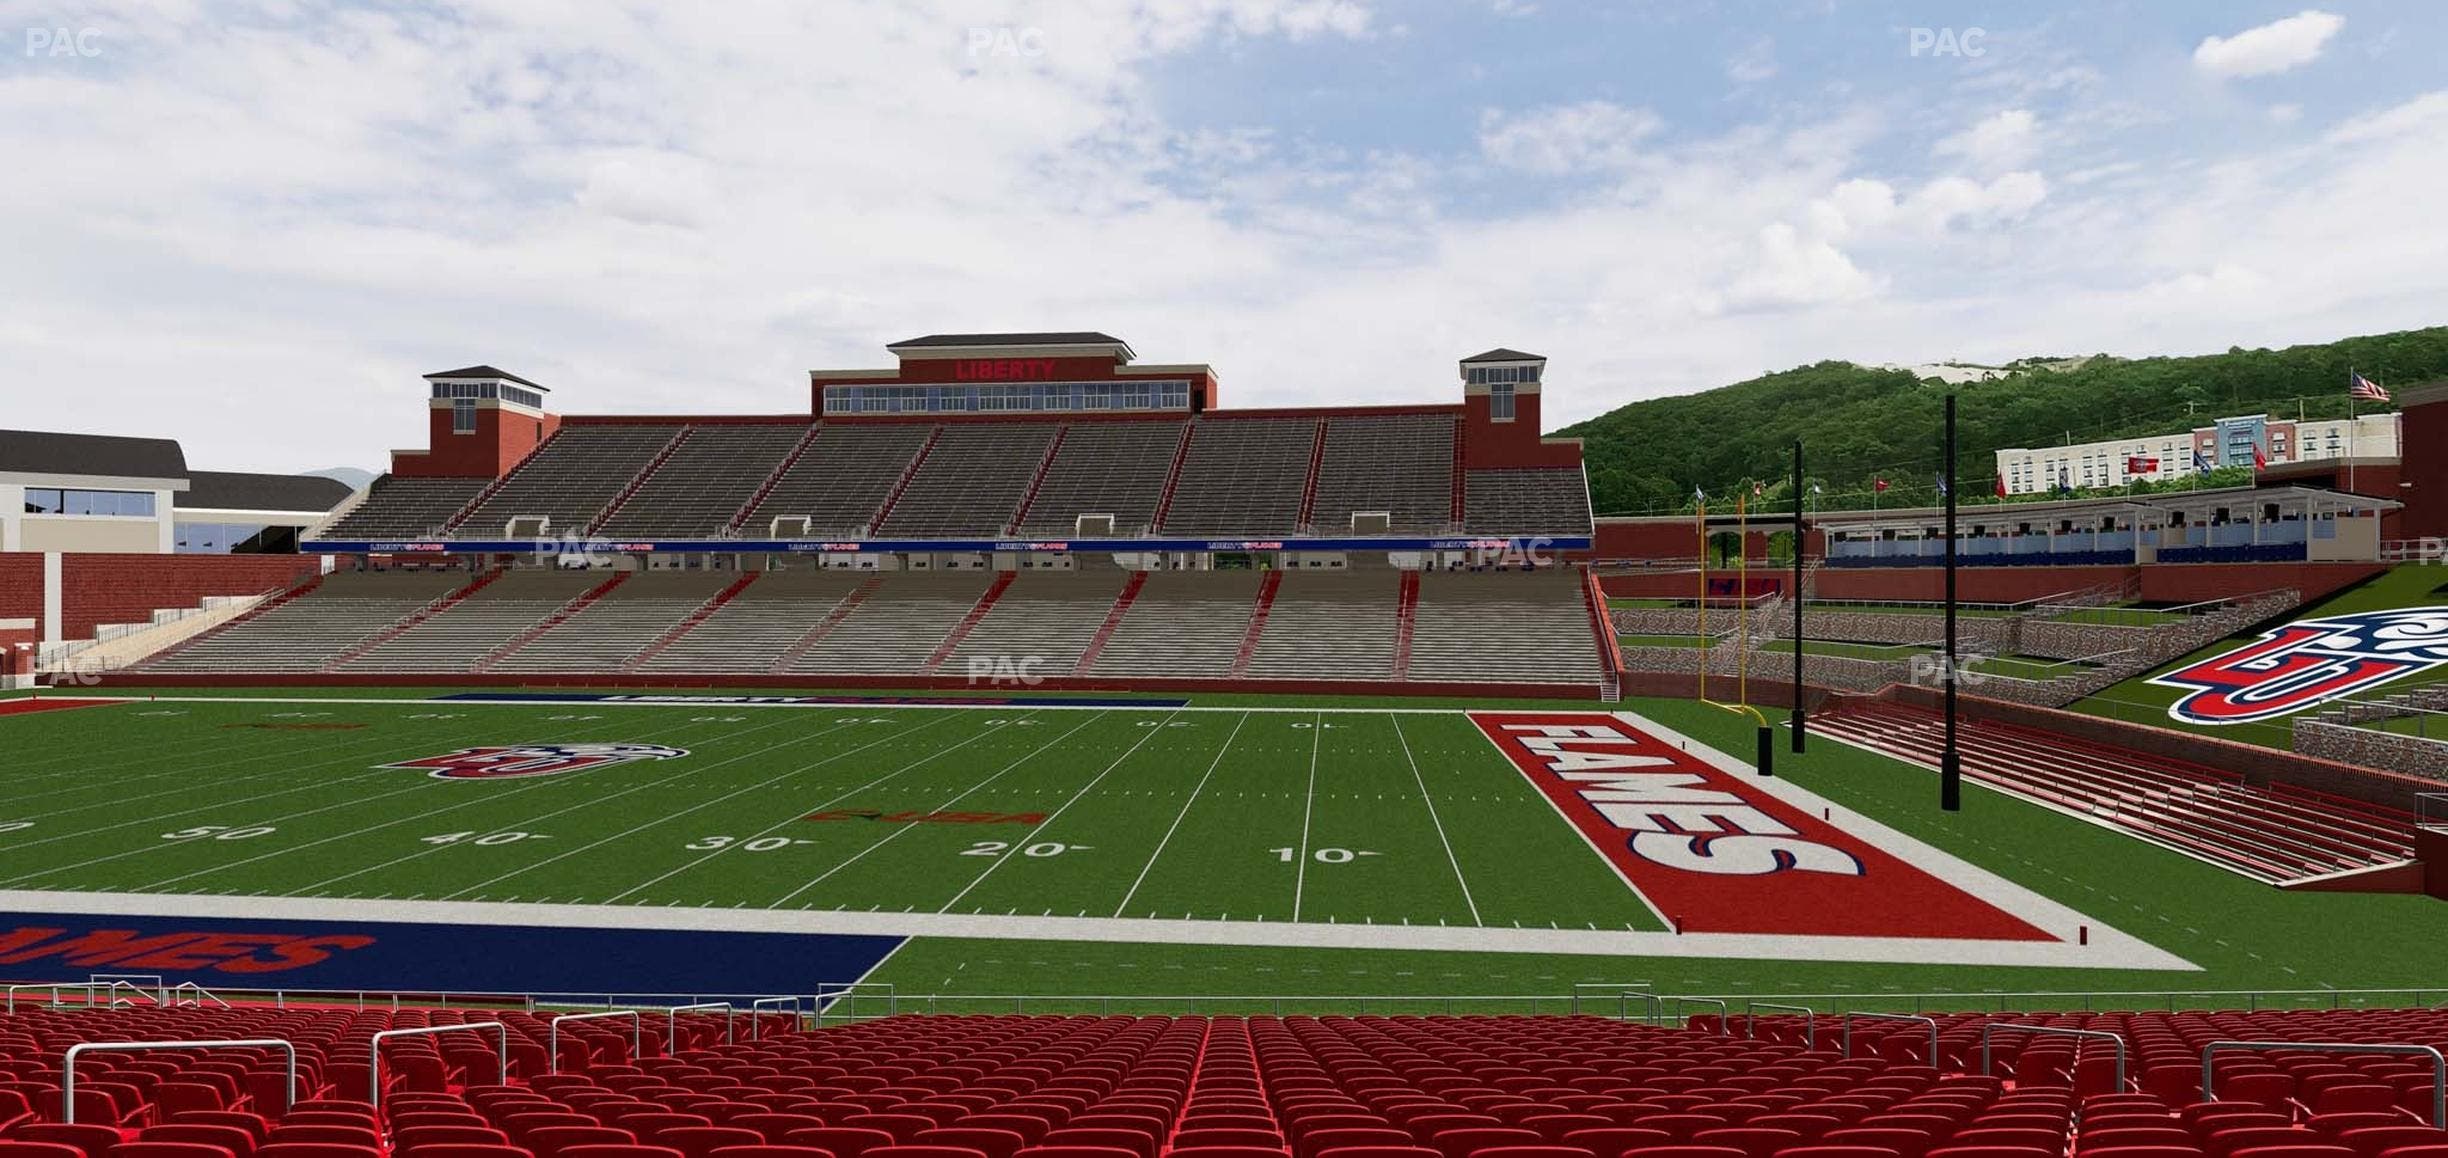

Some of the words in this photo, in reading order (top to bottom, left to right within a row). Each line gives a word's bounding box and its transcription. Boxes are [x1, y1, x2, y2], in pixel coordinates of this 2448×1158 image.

[955, 359, 1056, 380] LIBERTY
[1499, 724, 1867, 876] FLAMES
[161, 826, 276, 841] 50
[420, 831, 529, 845] 40
[685, 836, 791, 851] 30
[959, 842, 1065, 857] 20
[1269, 847, 1354, 863] 10
